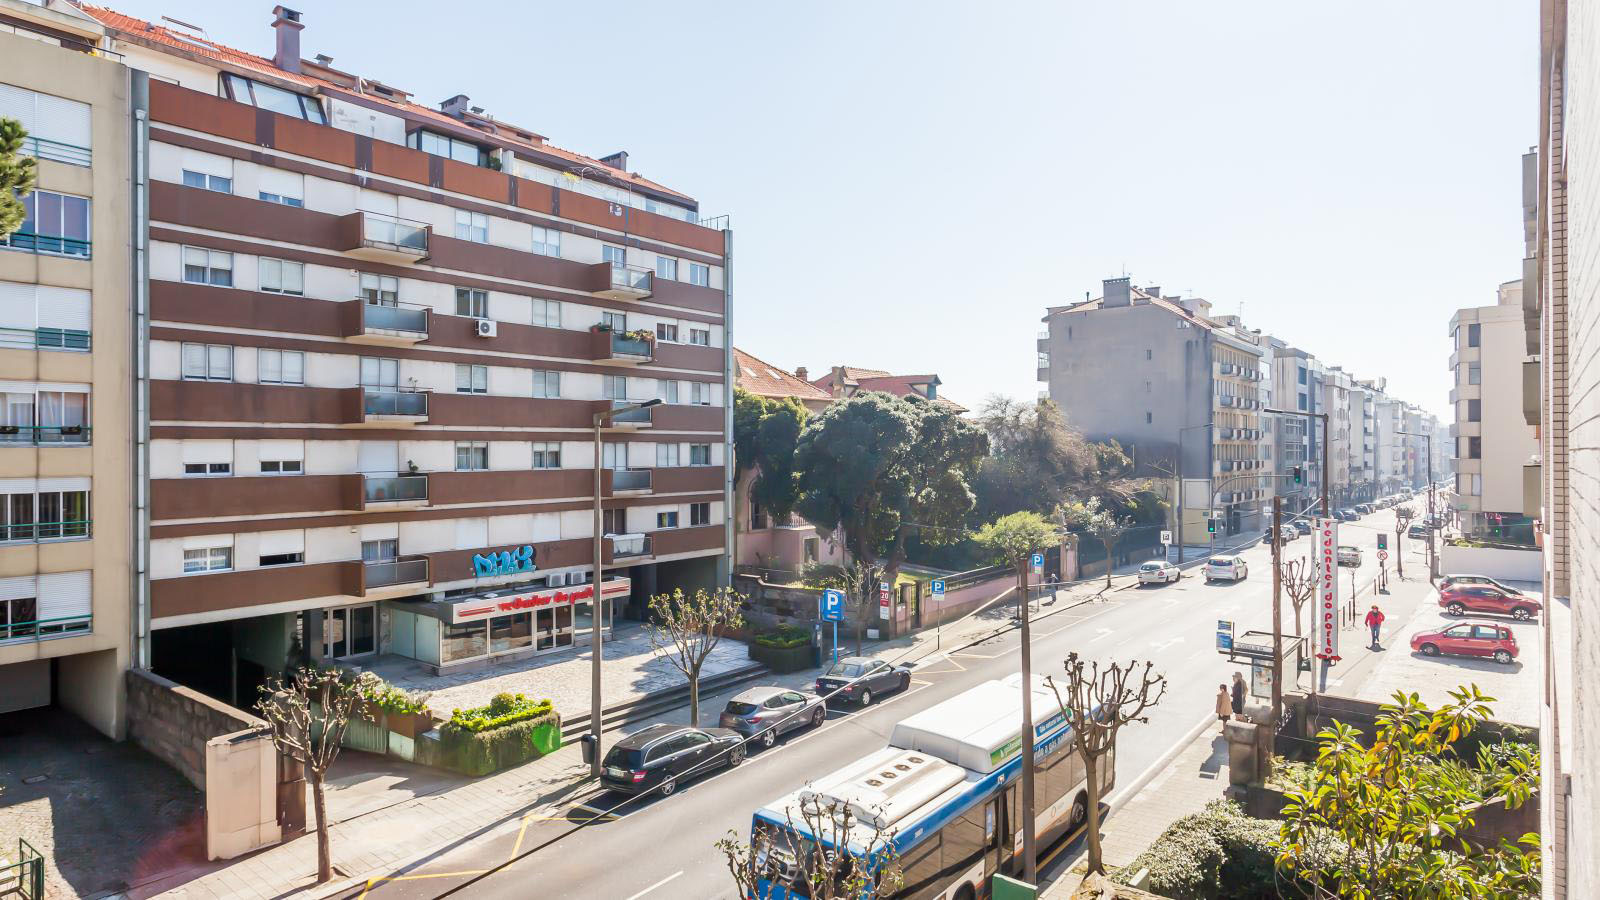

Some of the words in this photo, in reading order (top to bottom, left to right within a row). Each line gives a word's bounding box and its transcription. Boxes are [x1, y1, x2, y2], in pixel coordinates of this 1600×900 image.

[1034, 556, 1041, 565] P
[1323, 520, 1333, 590] vedantes
[934, 582, 942, 592] P
[827, 591, 839, 611] P
[880, 592, 889, 600] 20
[1324, 592, 1333, 609] do
[1324, 612, 1333, 655] porto
